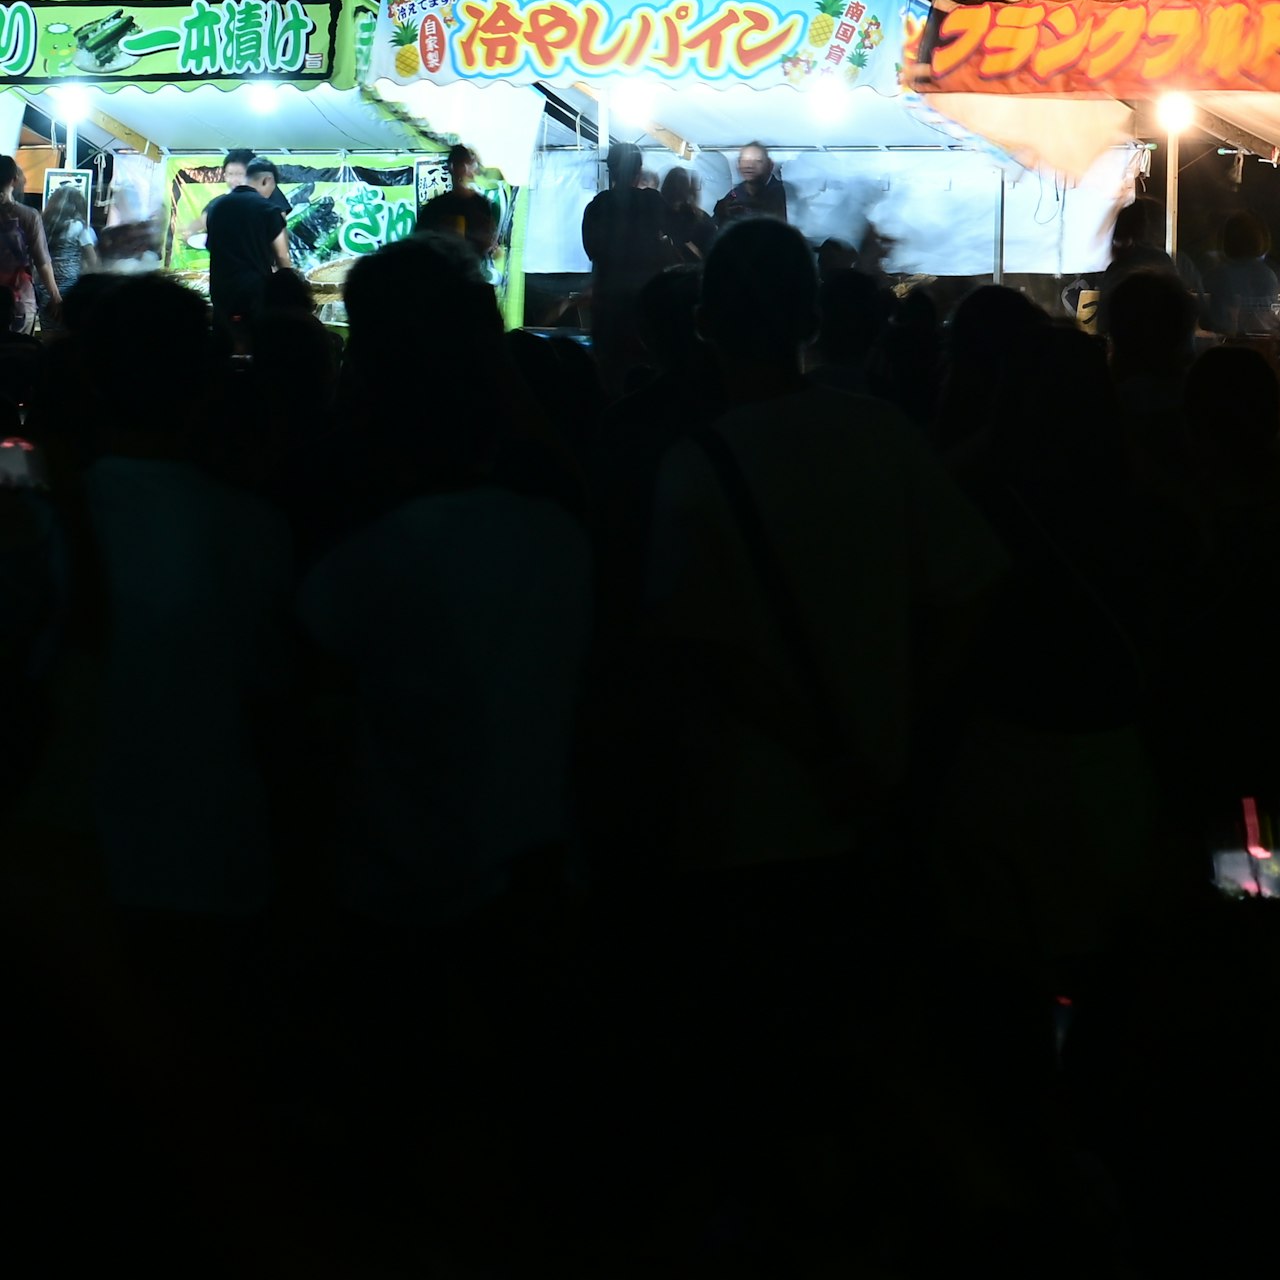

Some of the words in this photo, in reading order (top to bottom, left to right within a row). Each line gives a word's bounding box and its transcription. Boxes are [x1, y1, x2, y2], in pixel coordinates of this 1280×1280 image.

[424, 19, 441, 69] 自家製
[457, 1, 799, 69] 冷やしパイン
